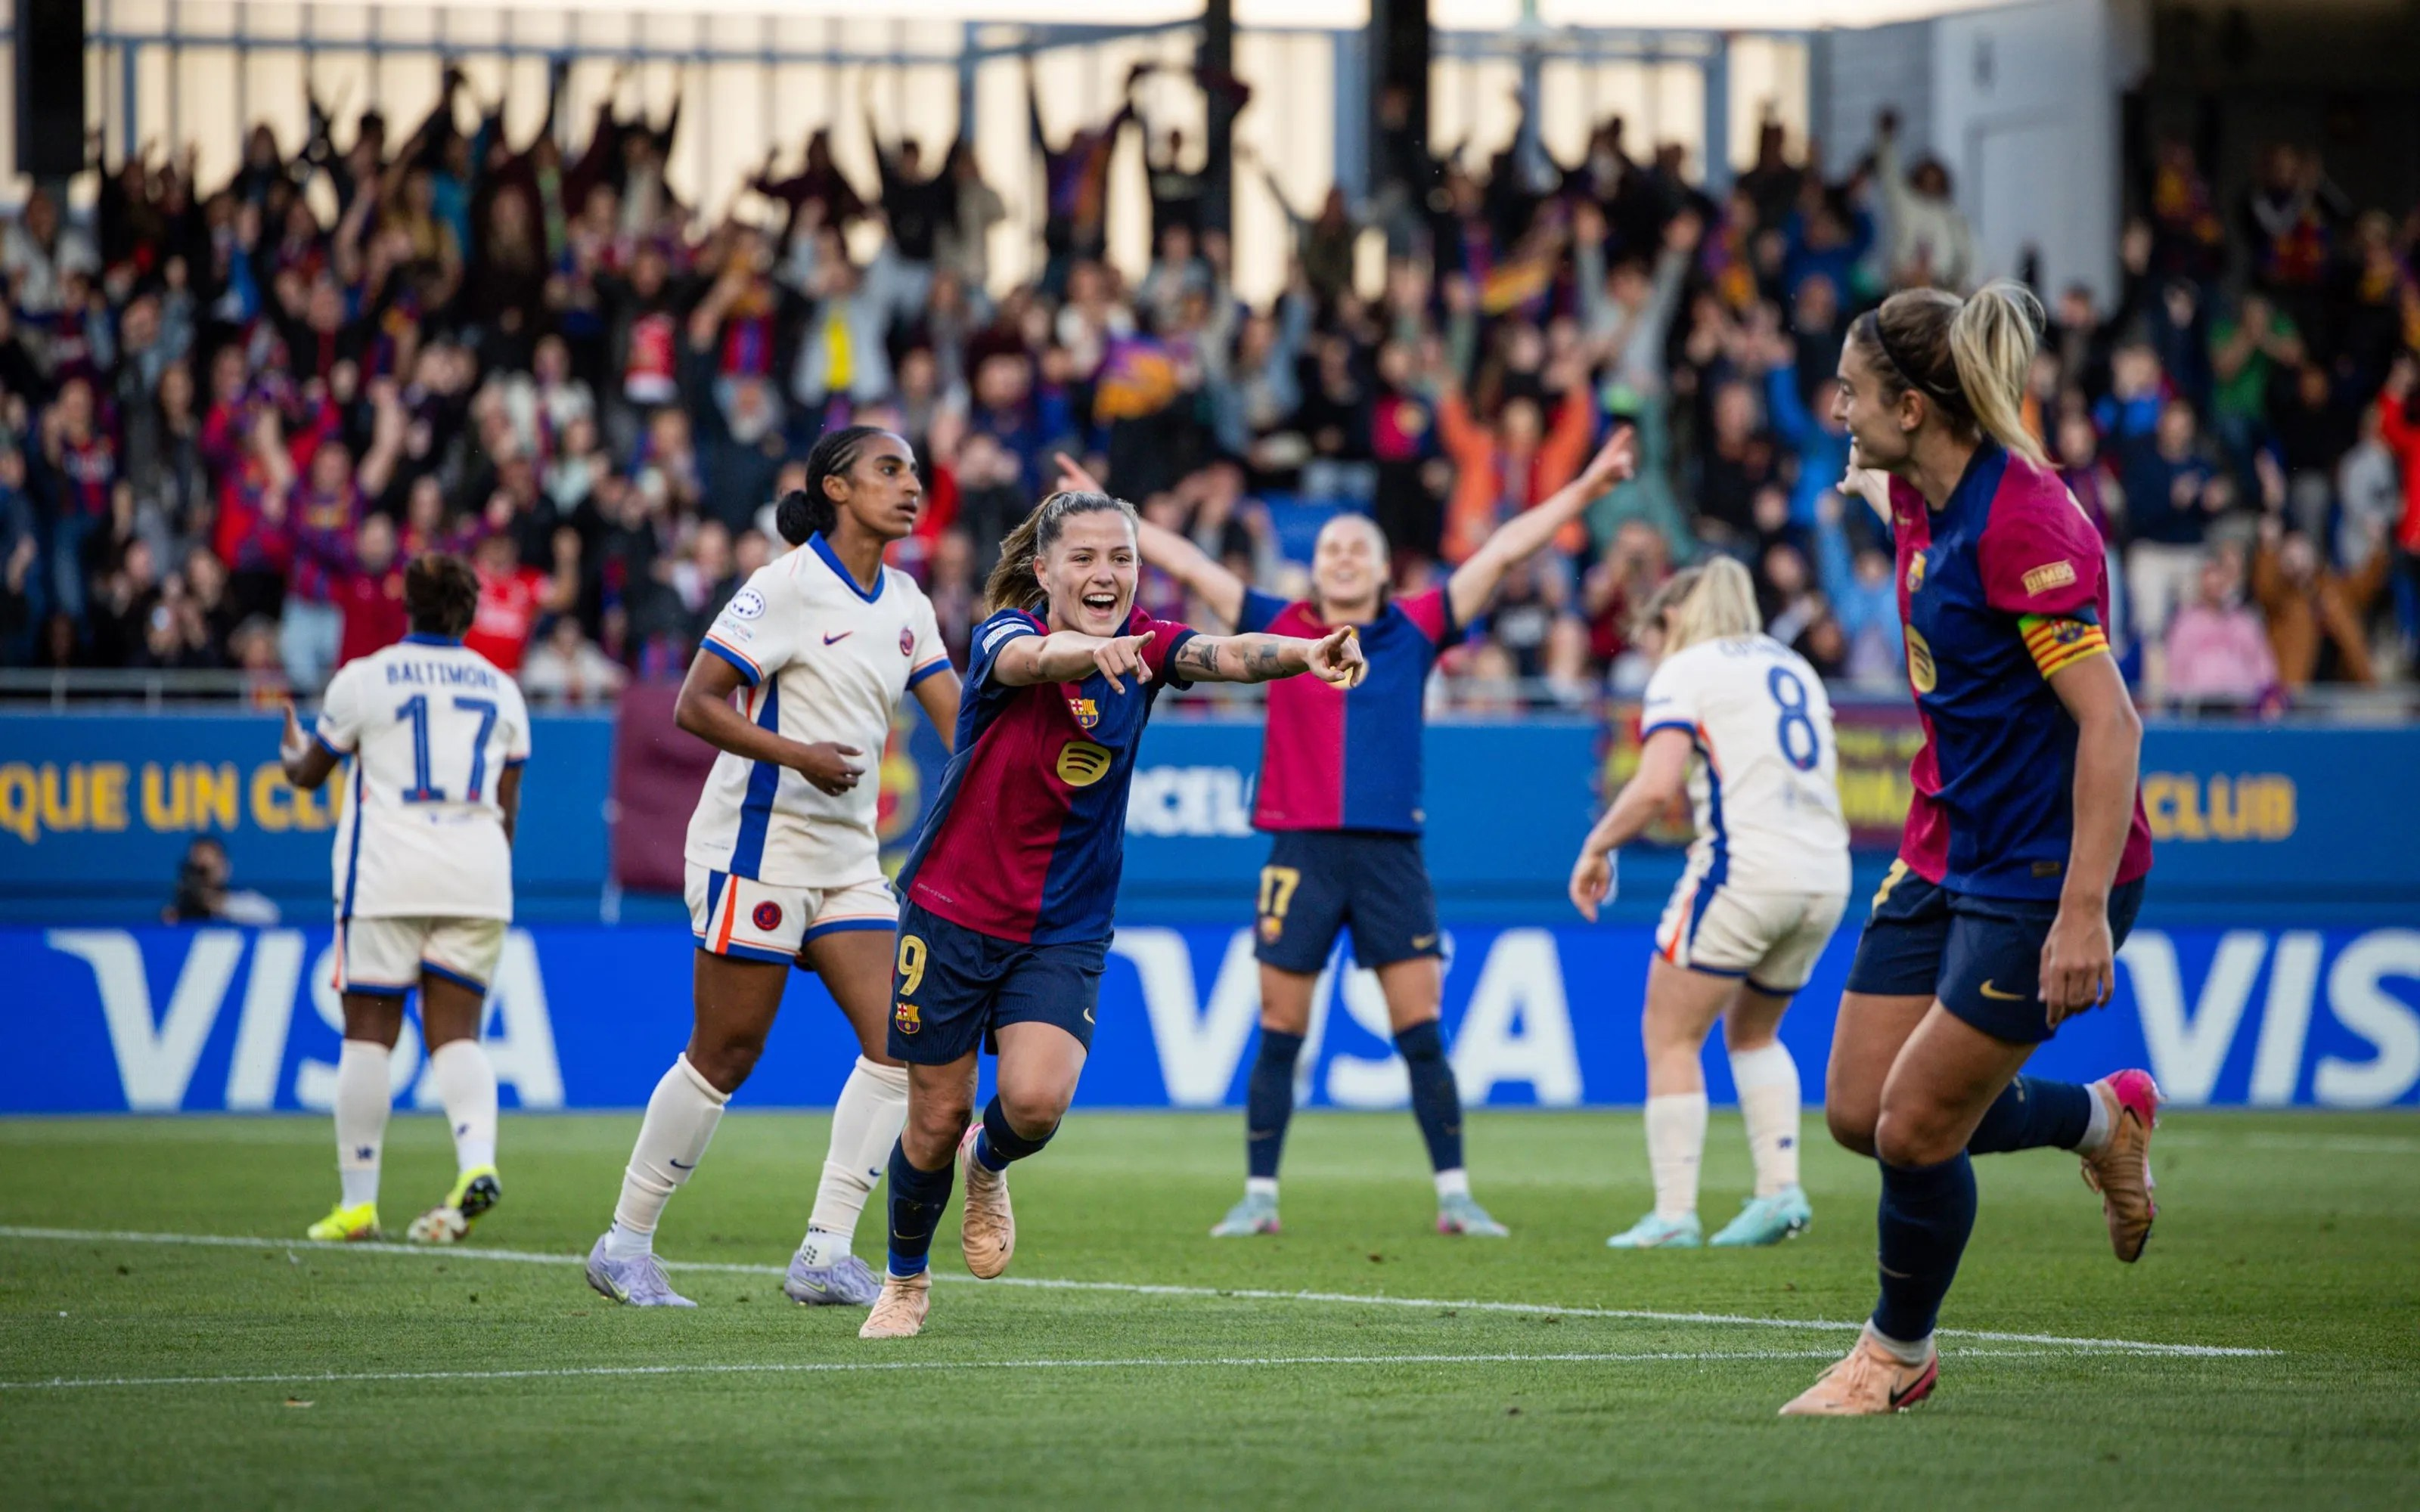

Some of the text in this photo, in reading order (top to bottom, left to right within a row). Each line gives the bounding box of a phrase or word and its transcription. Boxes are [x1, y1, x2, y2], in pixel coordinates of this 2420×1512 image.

[396, 694, 498, 801] 17
[1767, 665, 1820, 771] 8
[0, 762, 130, 844] QUE
[141, 762, 239, 832] UN
[2143, 771, 2297, 842] CLUB
[1258, 864, 1301, 917] 17
[898, 935, 927, 996] 9
[2115, 928, 2420, 1108] VIS
